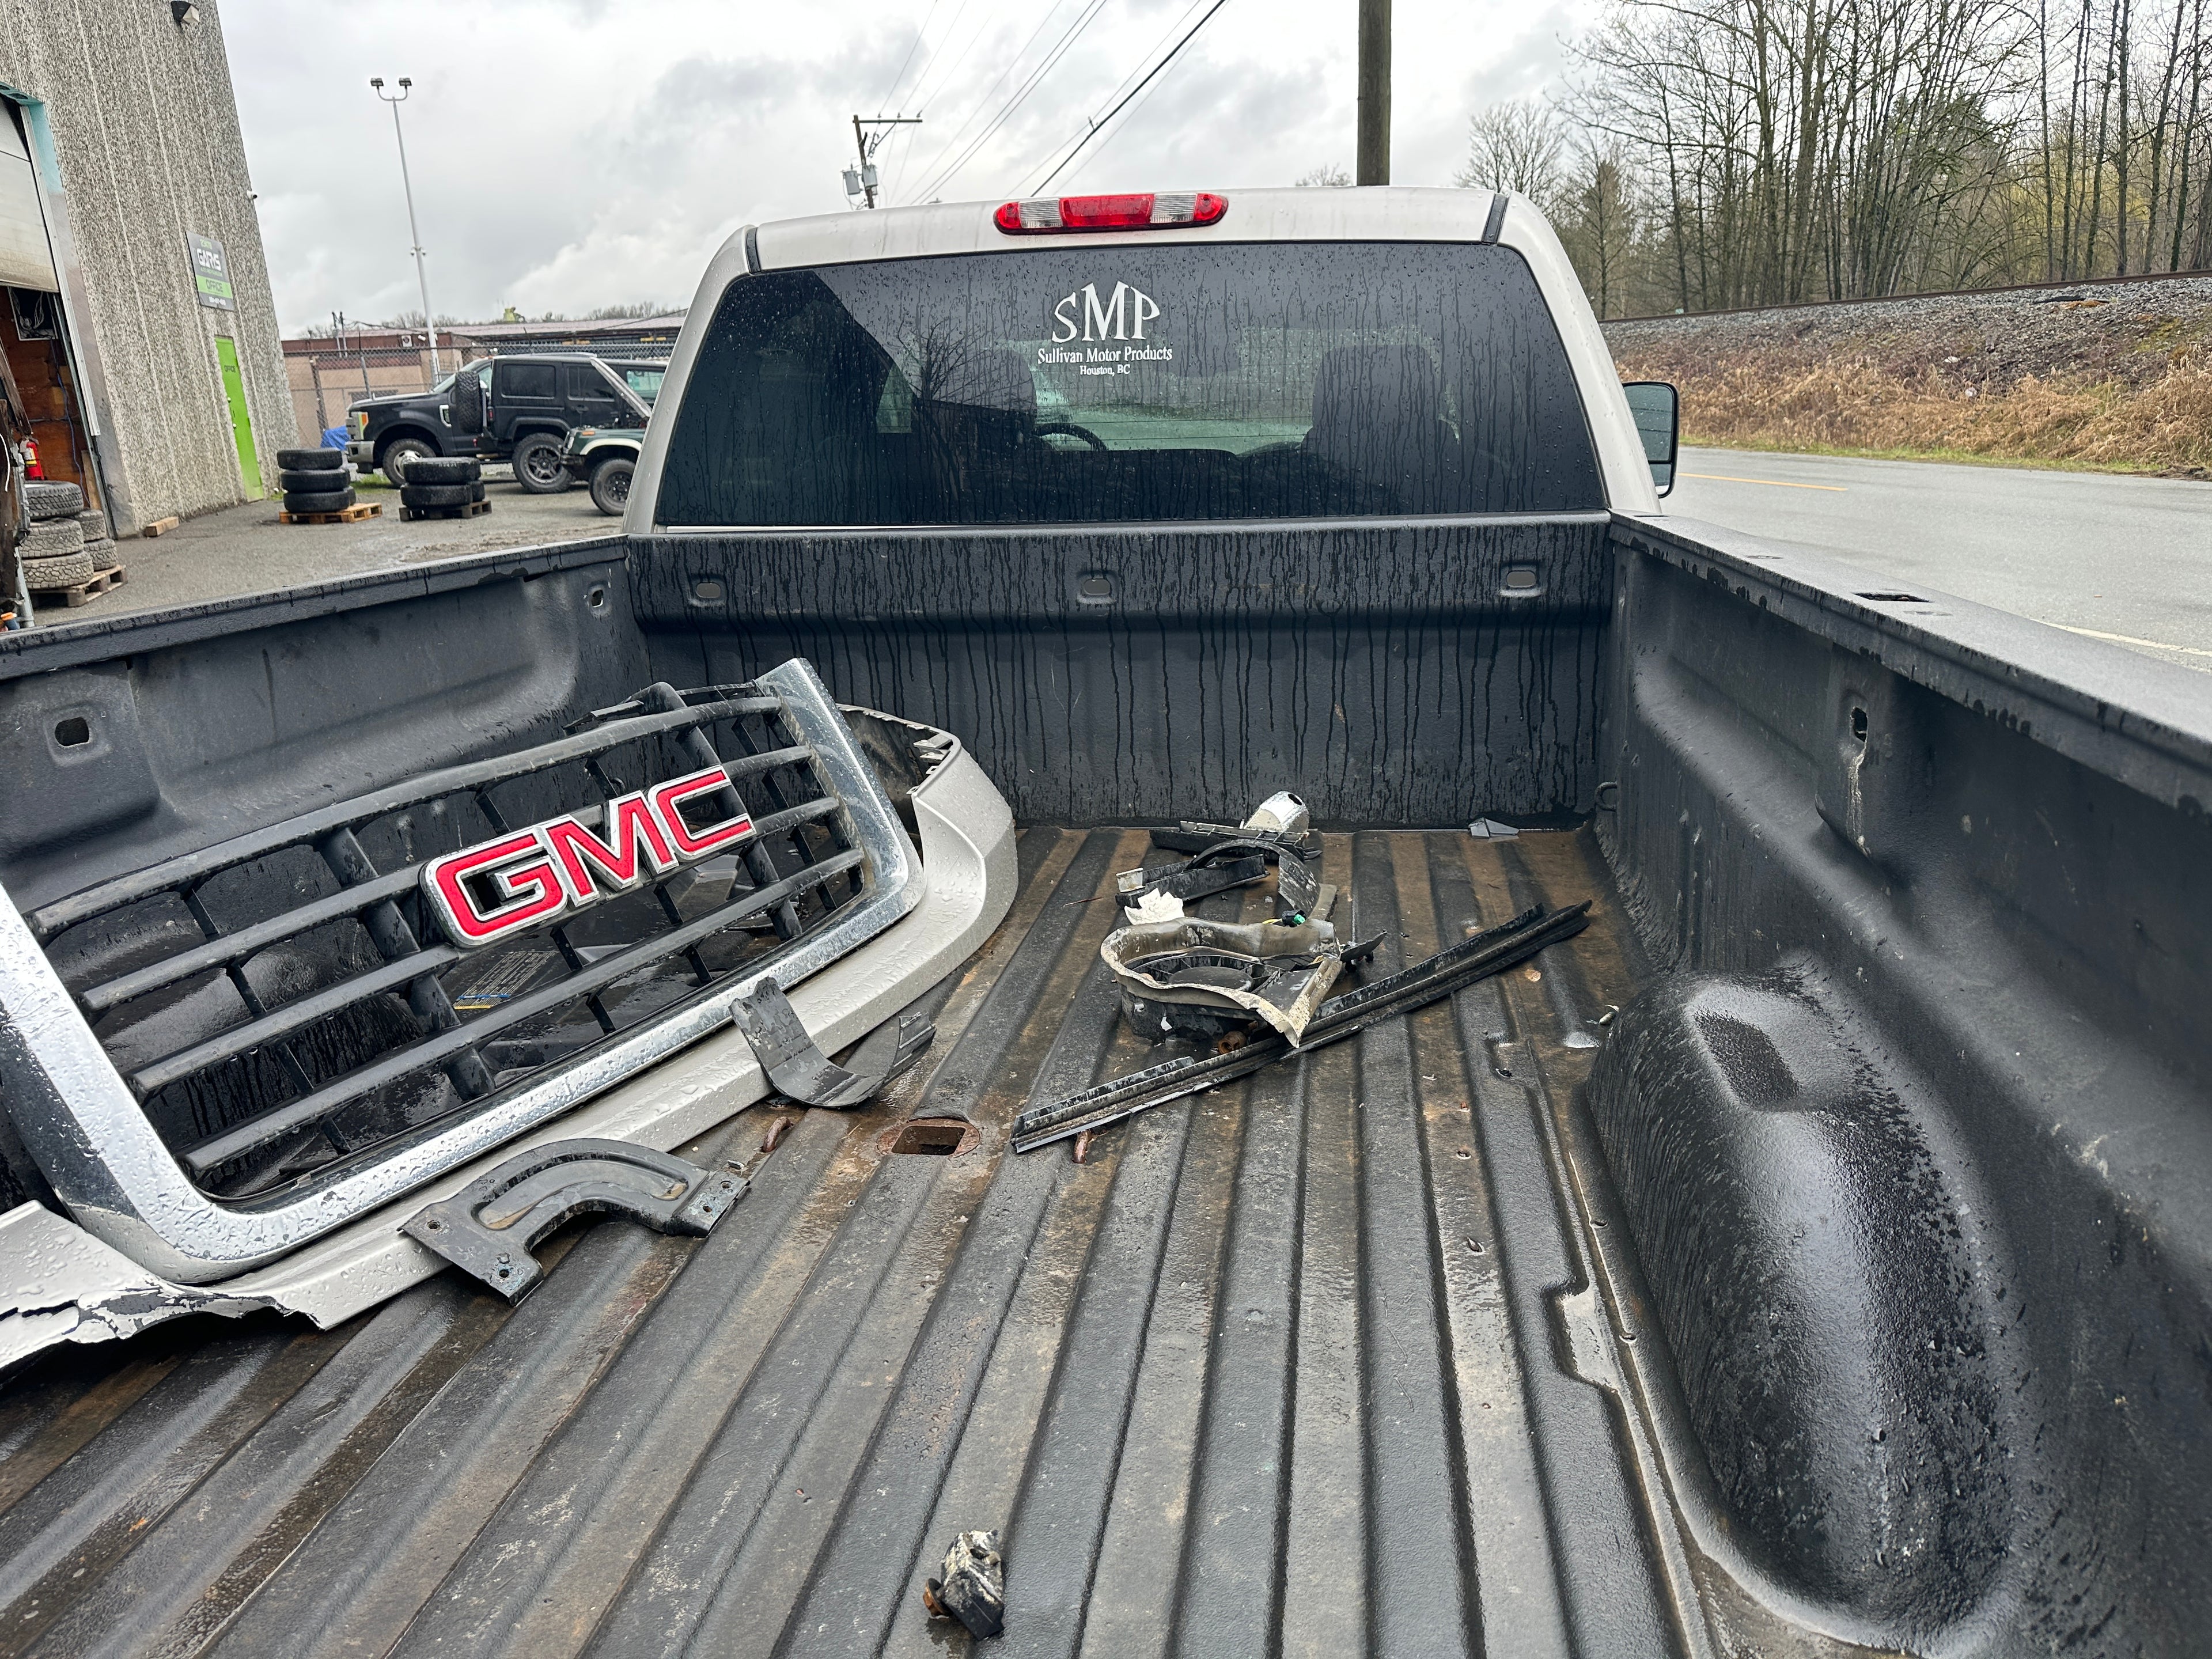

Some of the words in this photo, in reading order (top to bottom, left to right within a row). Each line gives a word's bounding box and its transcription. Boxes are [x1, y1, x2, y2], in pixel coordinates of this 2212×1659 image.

[206, 279, 224, 293] OFFICE
[1051, 281, 1160, 343] SMP
[1037, 347, 1083, 364] Sullivan
[1086, 347, 1122, 363] Motor
[1124, 345, 1173, 361] Products
[1080, 365, 1115, 377] Houston,
[1117, 363, 1130, 374] BC
[424, 764, 757, 946] GMC
